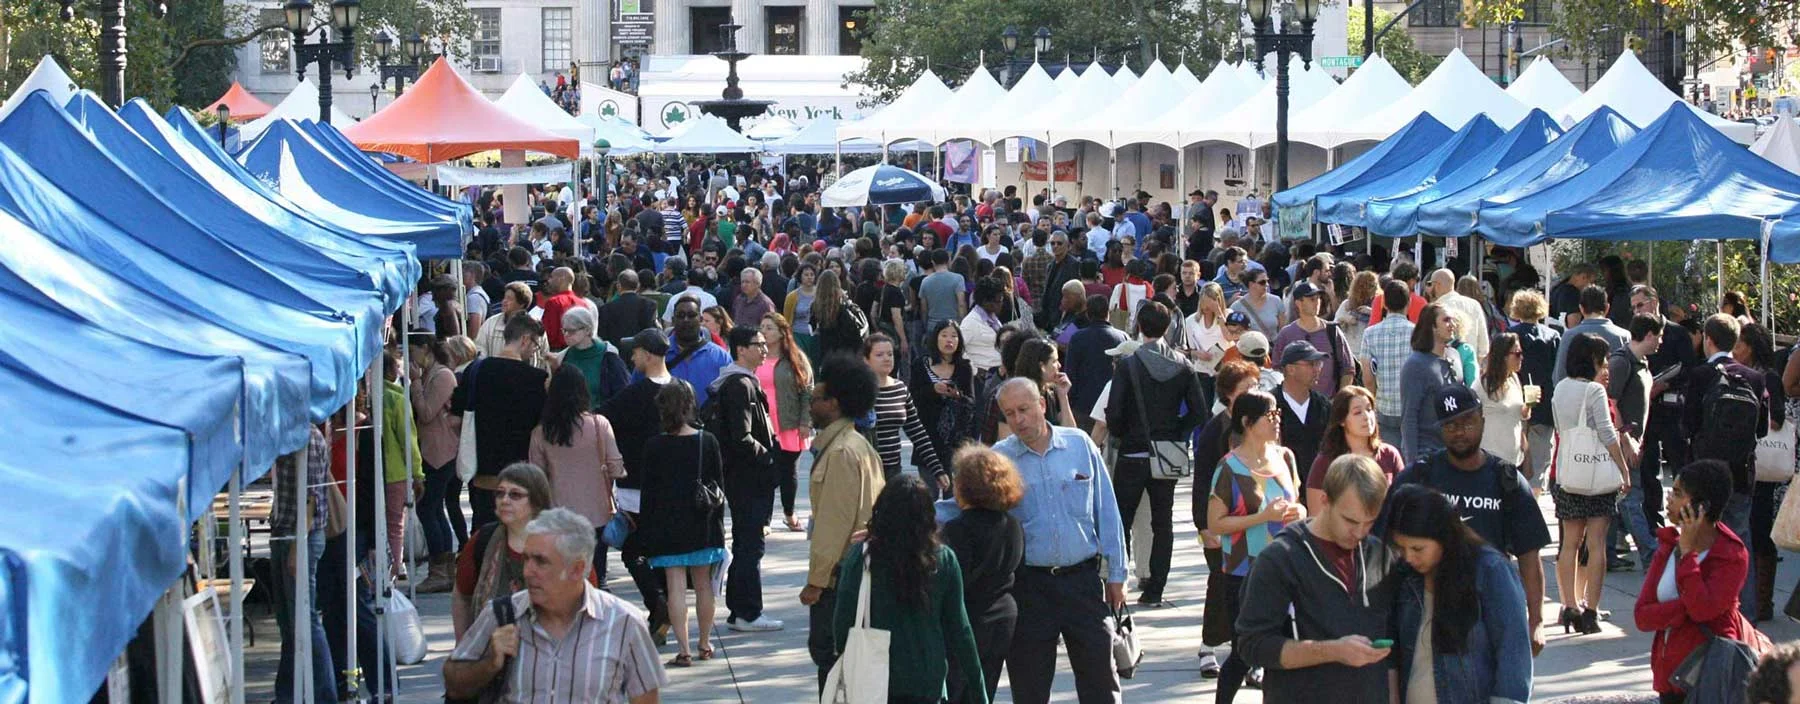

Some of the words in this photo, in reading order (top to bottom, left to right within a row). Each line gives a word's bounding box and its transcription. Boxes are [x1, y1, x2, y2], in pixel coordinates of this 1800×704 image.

[764, 105, 799, 120] New
[804, 105, 843, 120] York
[1226, 154, 1243, 178] PEN
[1573, 453, 1610, 464] GRANT
[1463, 496, 1502, 511] YORK
